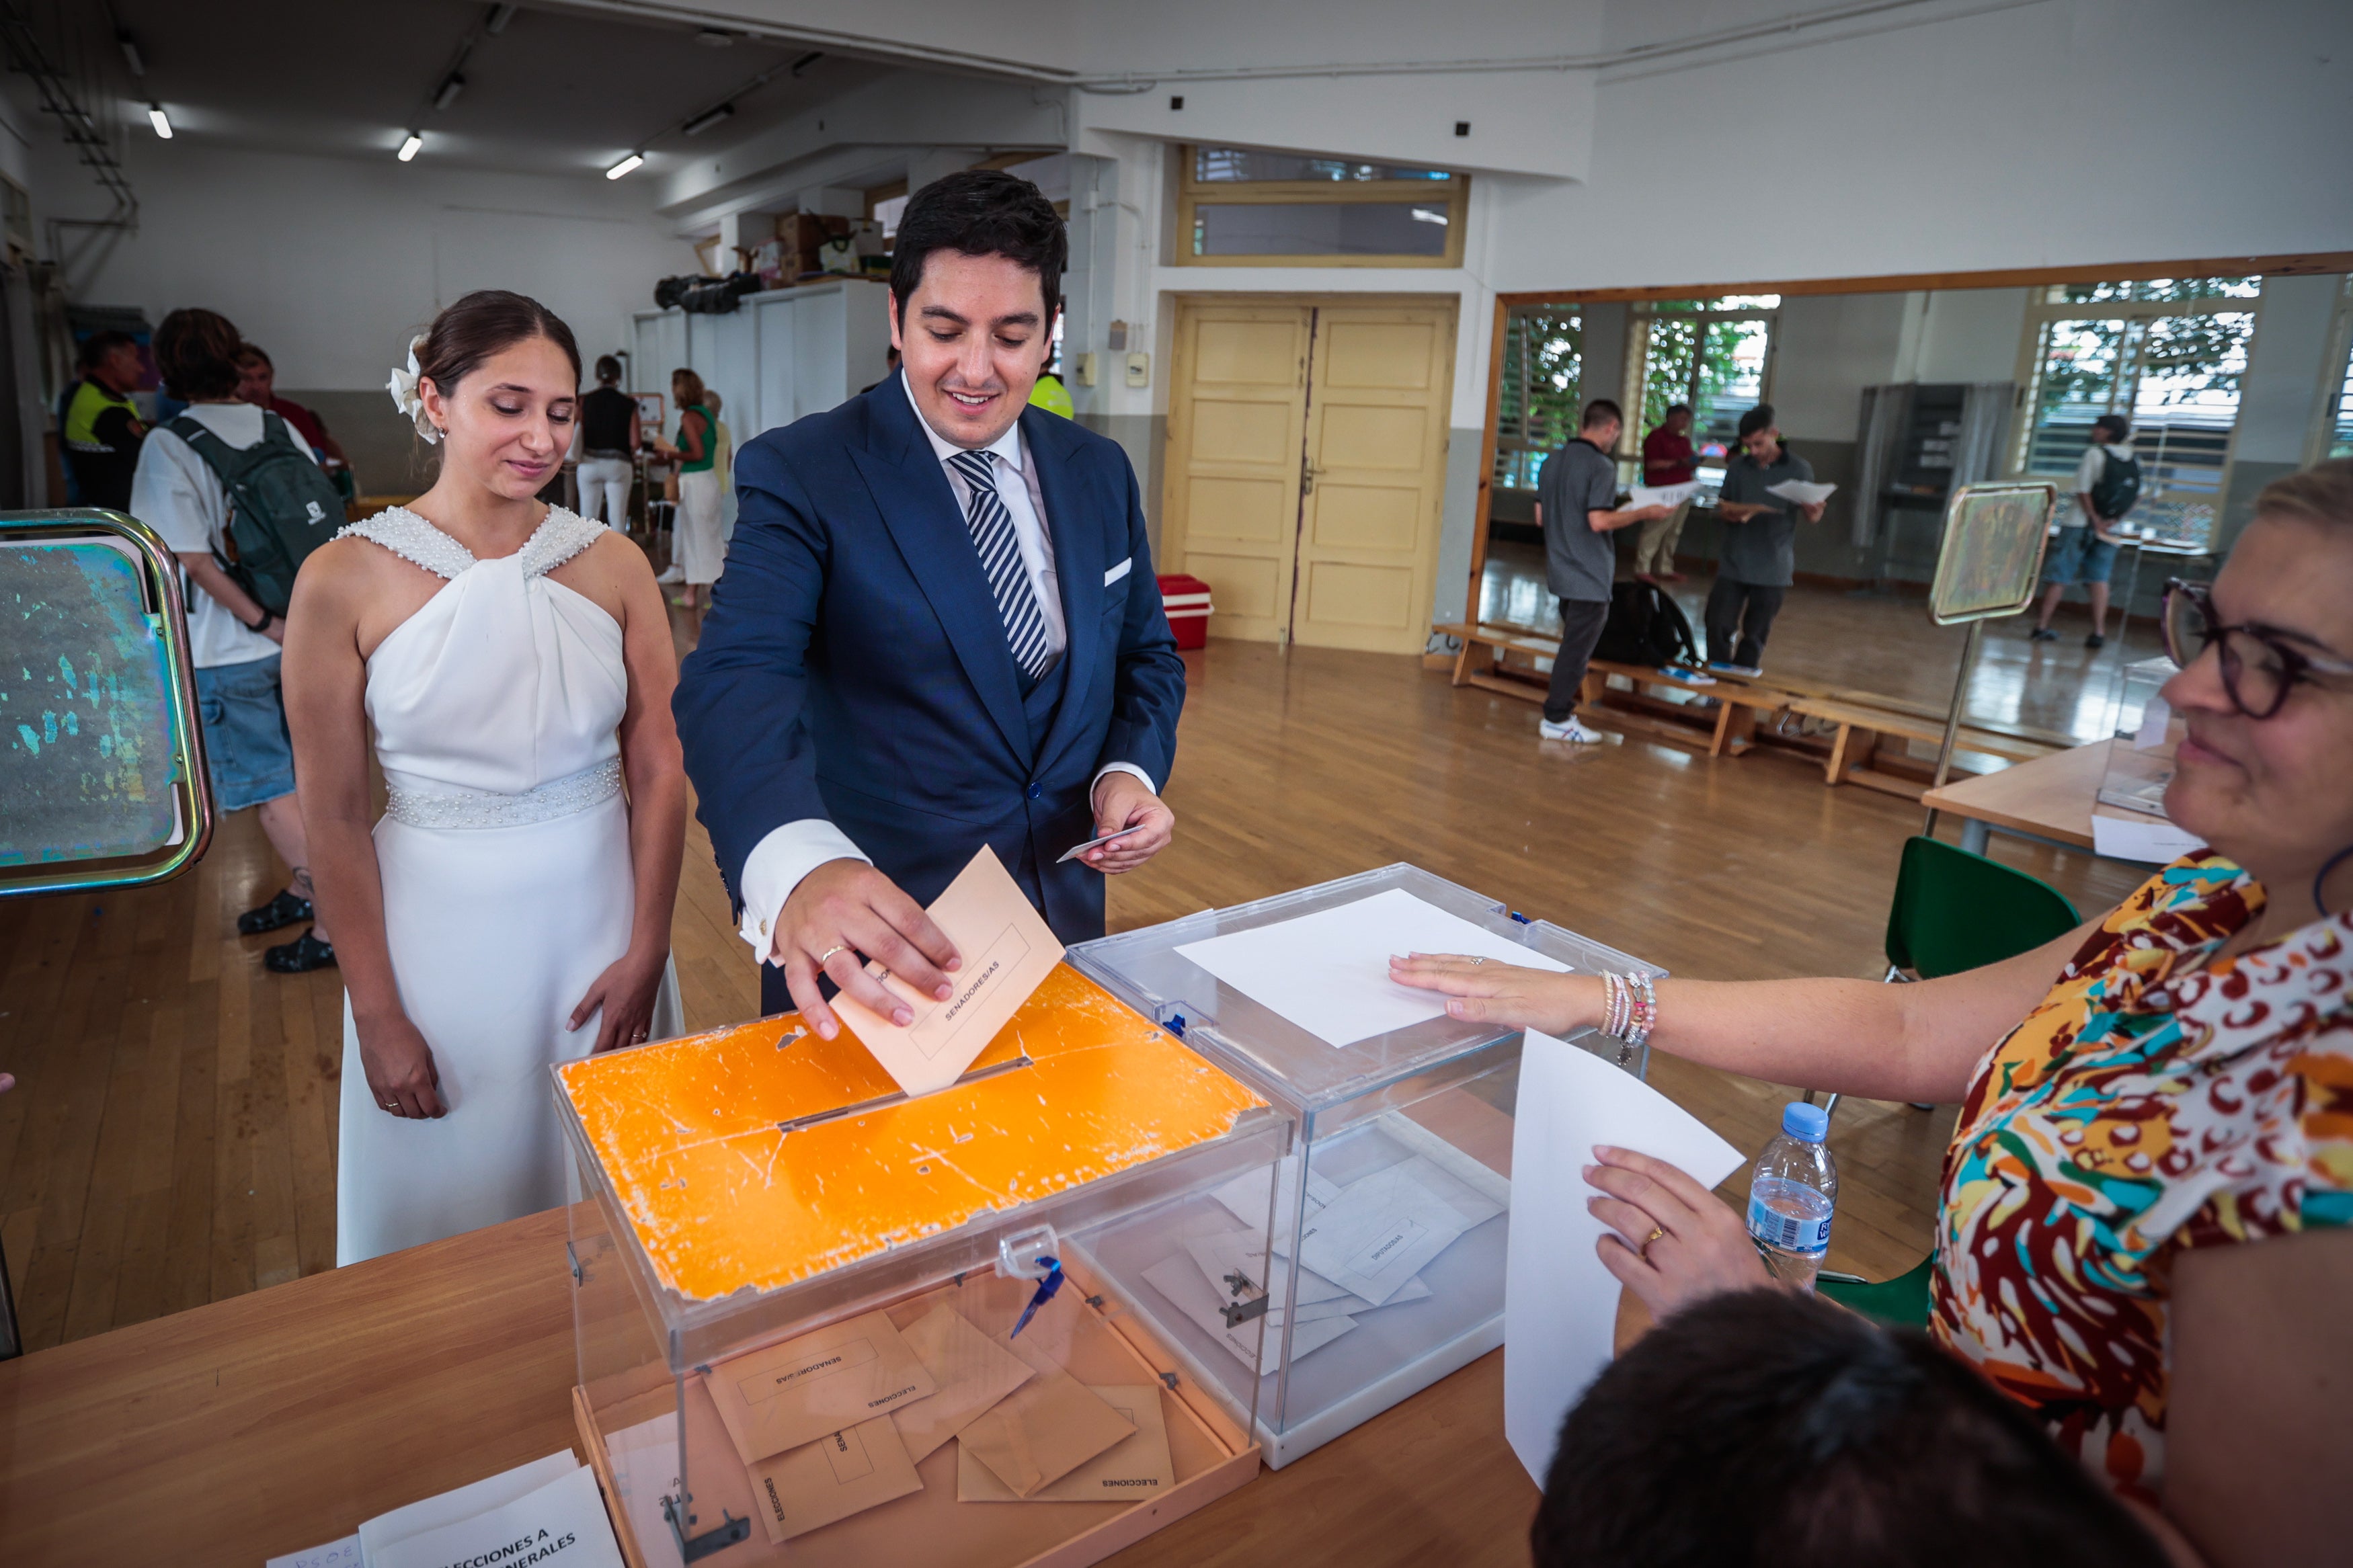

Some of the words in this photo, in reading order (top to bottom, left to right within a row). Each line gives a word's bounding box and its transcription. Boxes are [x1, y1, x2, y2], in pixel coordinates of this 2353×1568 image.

[945, 960, 1000, 1022] SENADORES/AS
[868, 1385, 916, 1408] ELECCIONES
[764, 1477, 785, 1522] ELECCIONES
[537, 1528, 549, 1541] A
